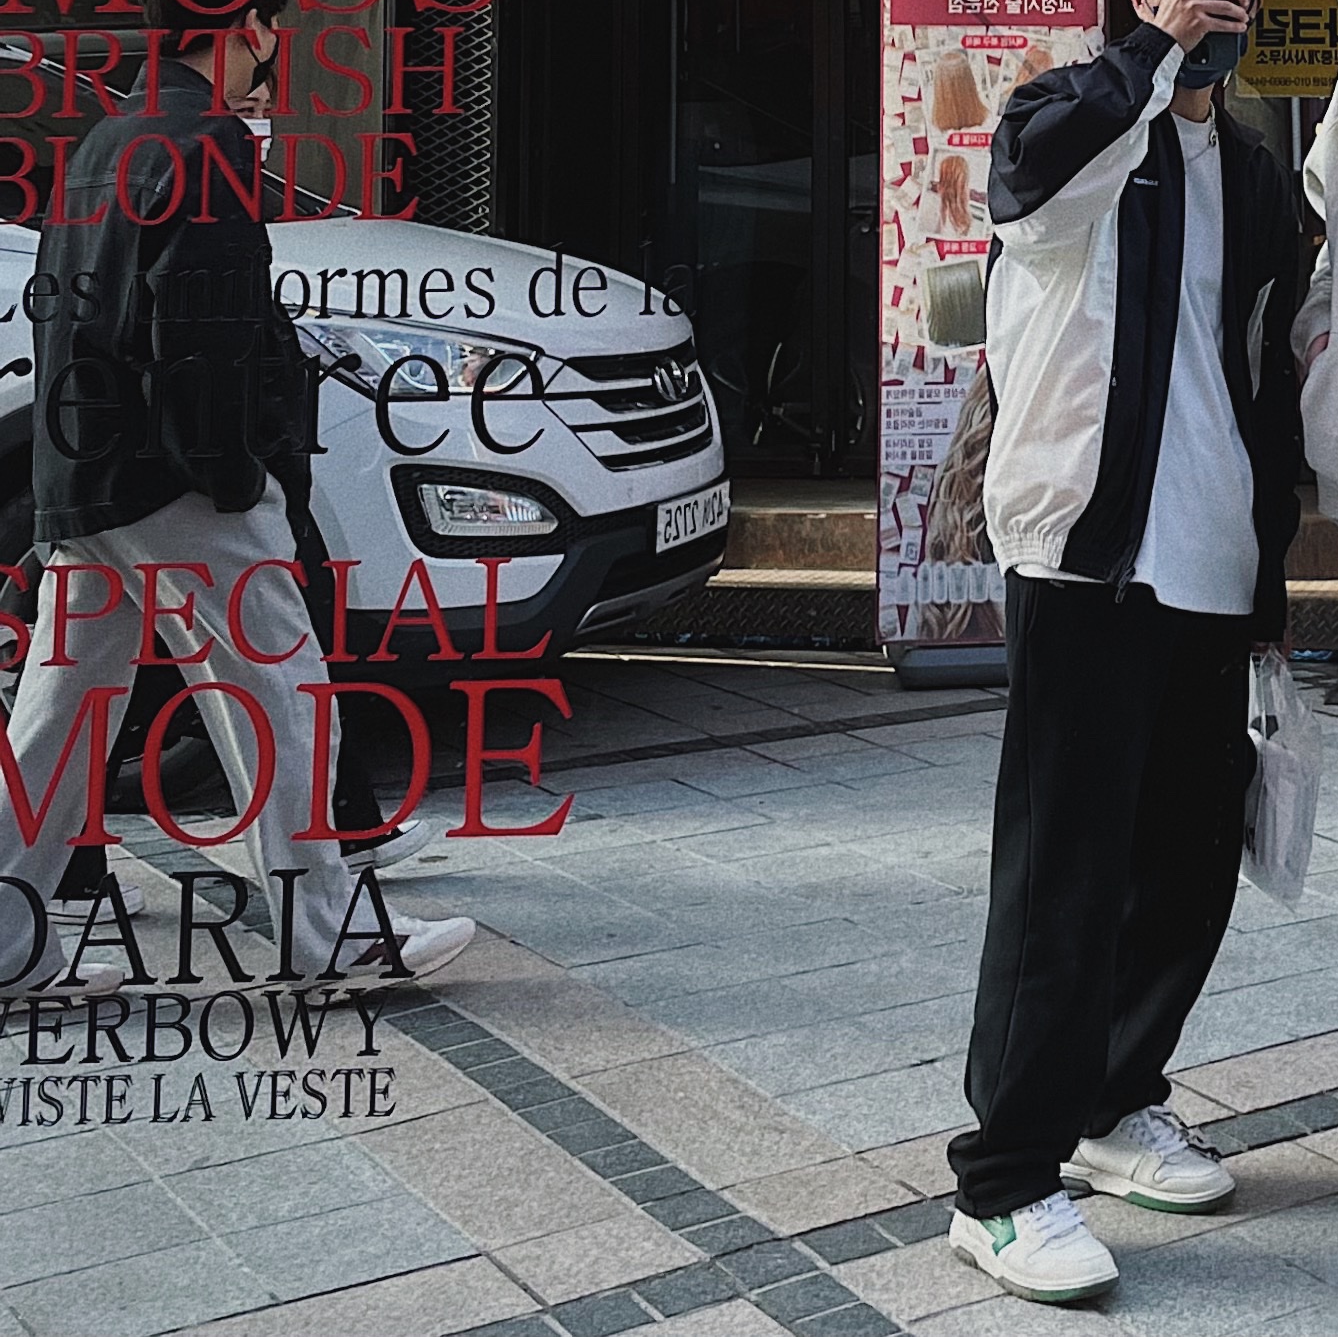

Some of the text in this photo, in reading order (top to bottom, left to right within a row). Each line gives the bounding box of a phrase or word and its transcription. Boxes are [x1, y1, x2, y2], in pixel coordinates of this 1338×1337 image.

[0, 25, 465, 120] BRITISH
[0, 131, 420, 227] BLONDE
[0, 267, 101, 324] es
[527, 243, 610, 320] de
[639, 241, 701, 319] la
[0, 987, 389, 1066] ERBOWY
[0, 1066, 399, 1128] ISTE LA VESTE
